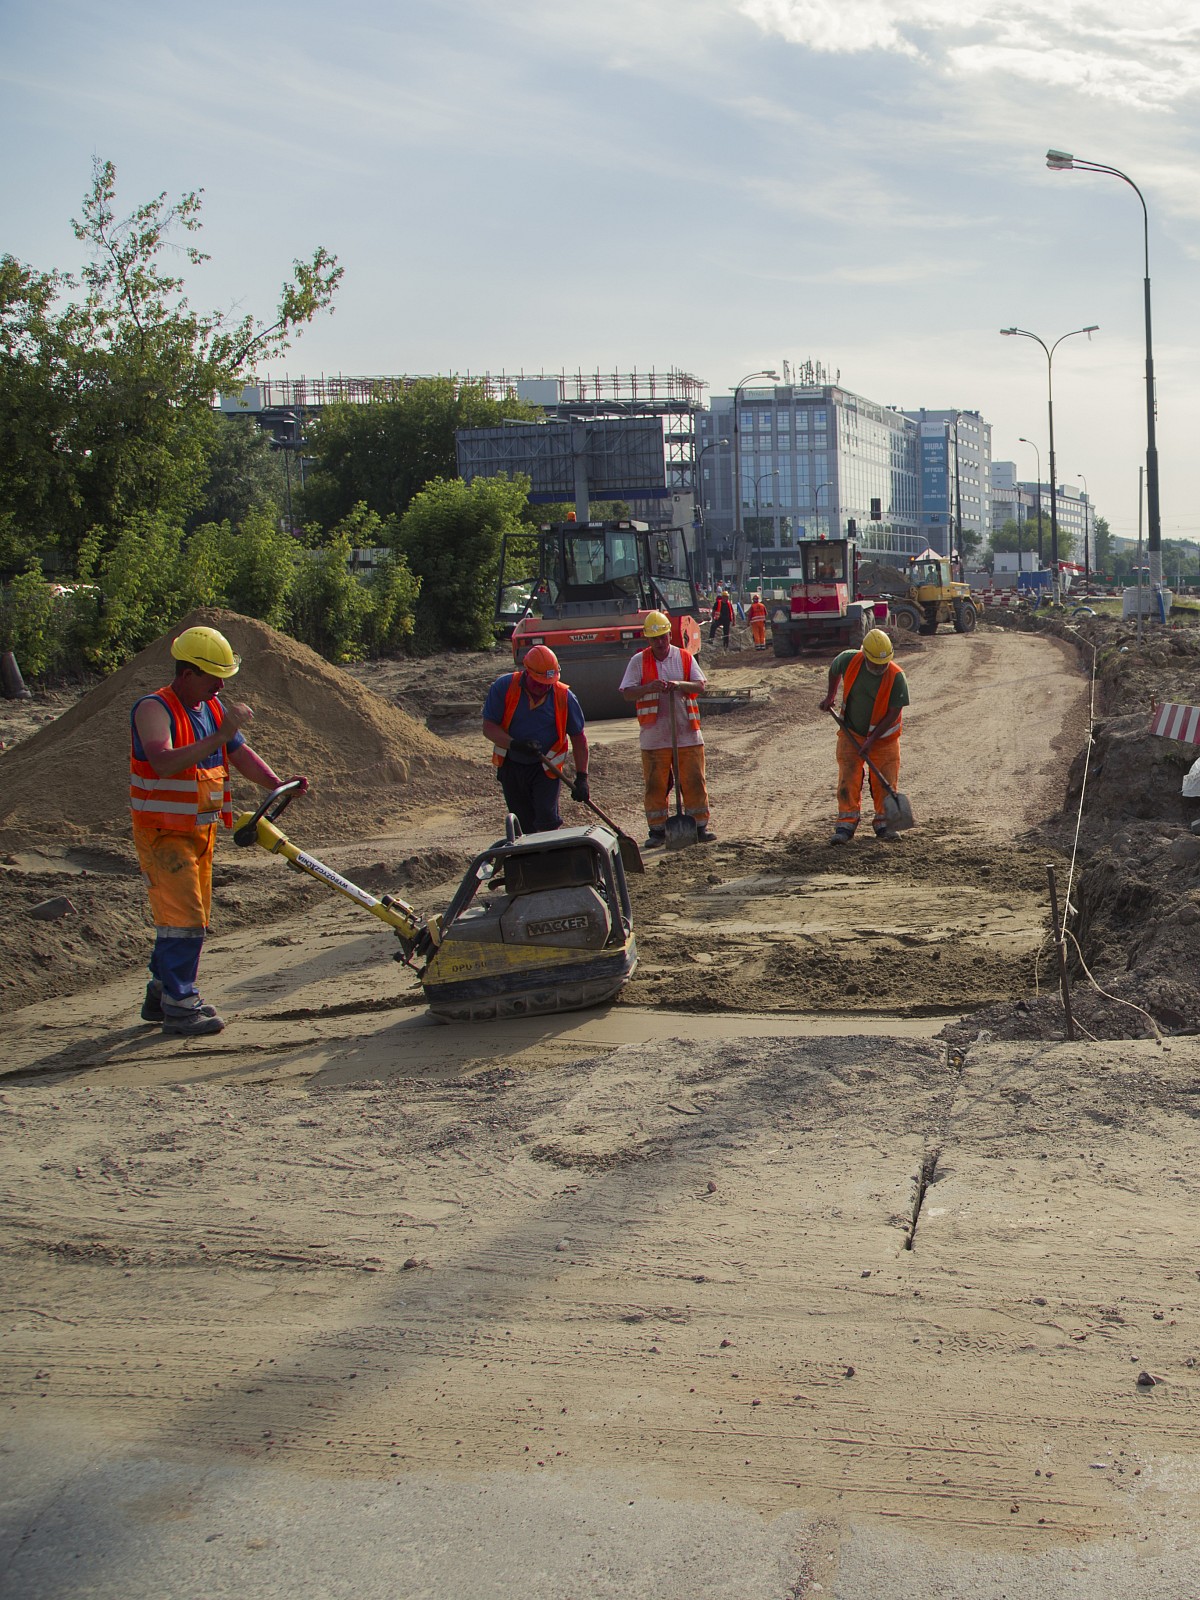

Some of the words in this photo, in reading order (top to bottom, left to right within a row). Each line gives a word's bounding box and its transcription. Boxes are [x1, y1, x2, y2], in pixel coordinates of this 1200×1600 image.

[923, 442, 944, 450] BIURA
[572, 634, 595, 642] HAMM
[527, 916, 589, 936] WACKER
